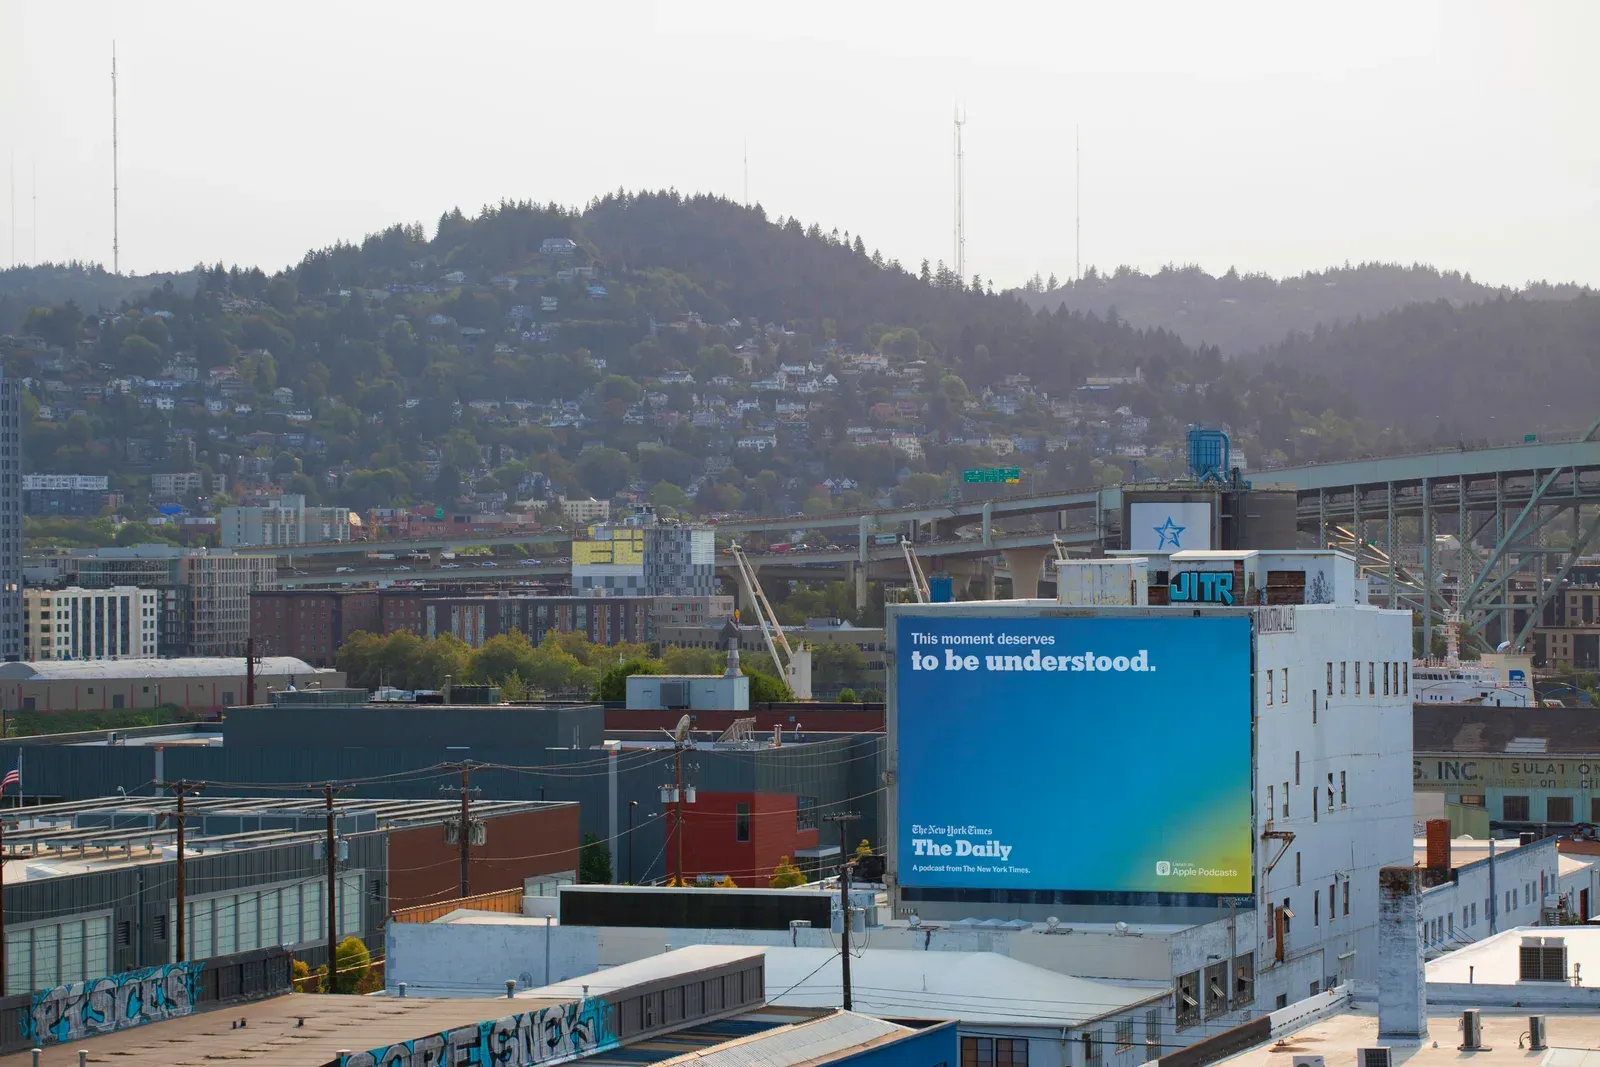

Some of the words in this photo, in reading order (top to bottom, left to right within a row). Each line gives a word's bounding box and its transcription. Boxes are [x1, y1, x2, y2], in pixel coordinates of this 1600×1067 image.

[1169, 570, 1235, 606] JITR
[911, 633, 938, 645] This
[941, 634, 994, 645] moment
[997, 633, 1055, 645] deserves
[911, 651, 939, 671] to
[945, 649, 980, 671] be
[985, 649, 1156, 672] understood.
[1437, 761, 1484, 780] INC.
[912, 825, 928, 835] The
[928, 826, 946, 835] New
[947, 825, 967, 836] York
[967, 826, 993, 835] Times
[912, 839, 953, 856] The
[955, 840, 1012, 861] Daily
[919, 864, 945, 872] podcast
[963, 865, 976, 873] The
[1008, 866, 1031, 874] Times.
[1172, 868, 1197, 877] Apple
[1198, 868, 1238, 877] Podcasts
